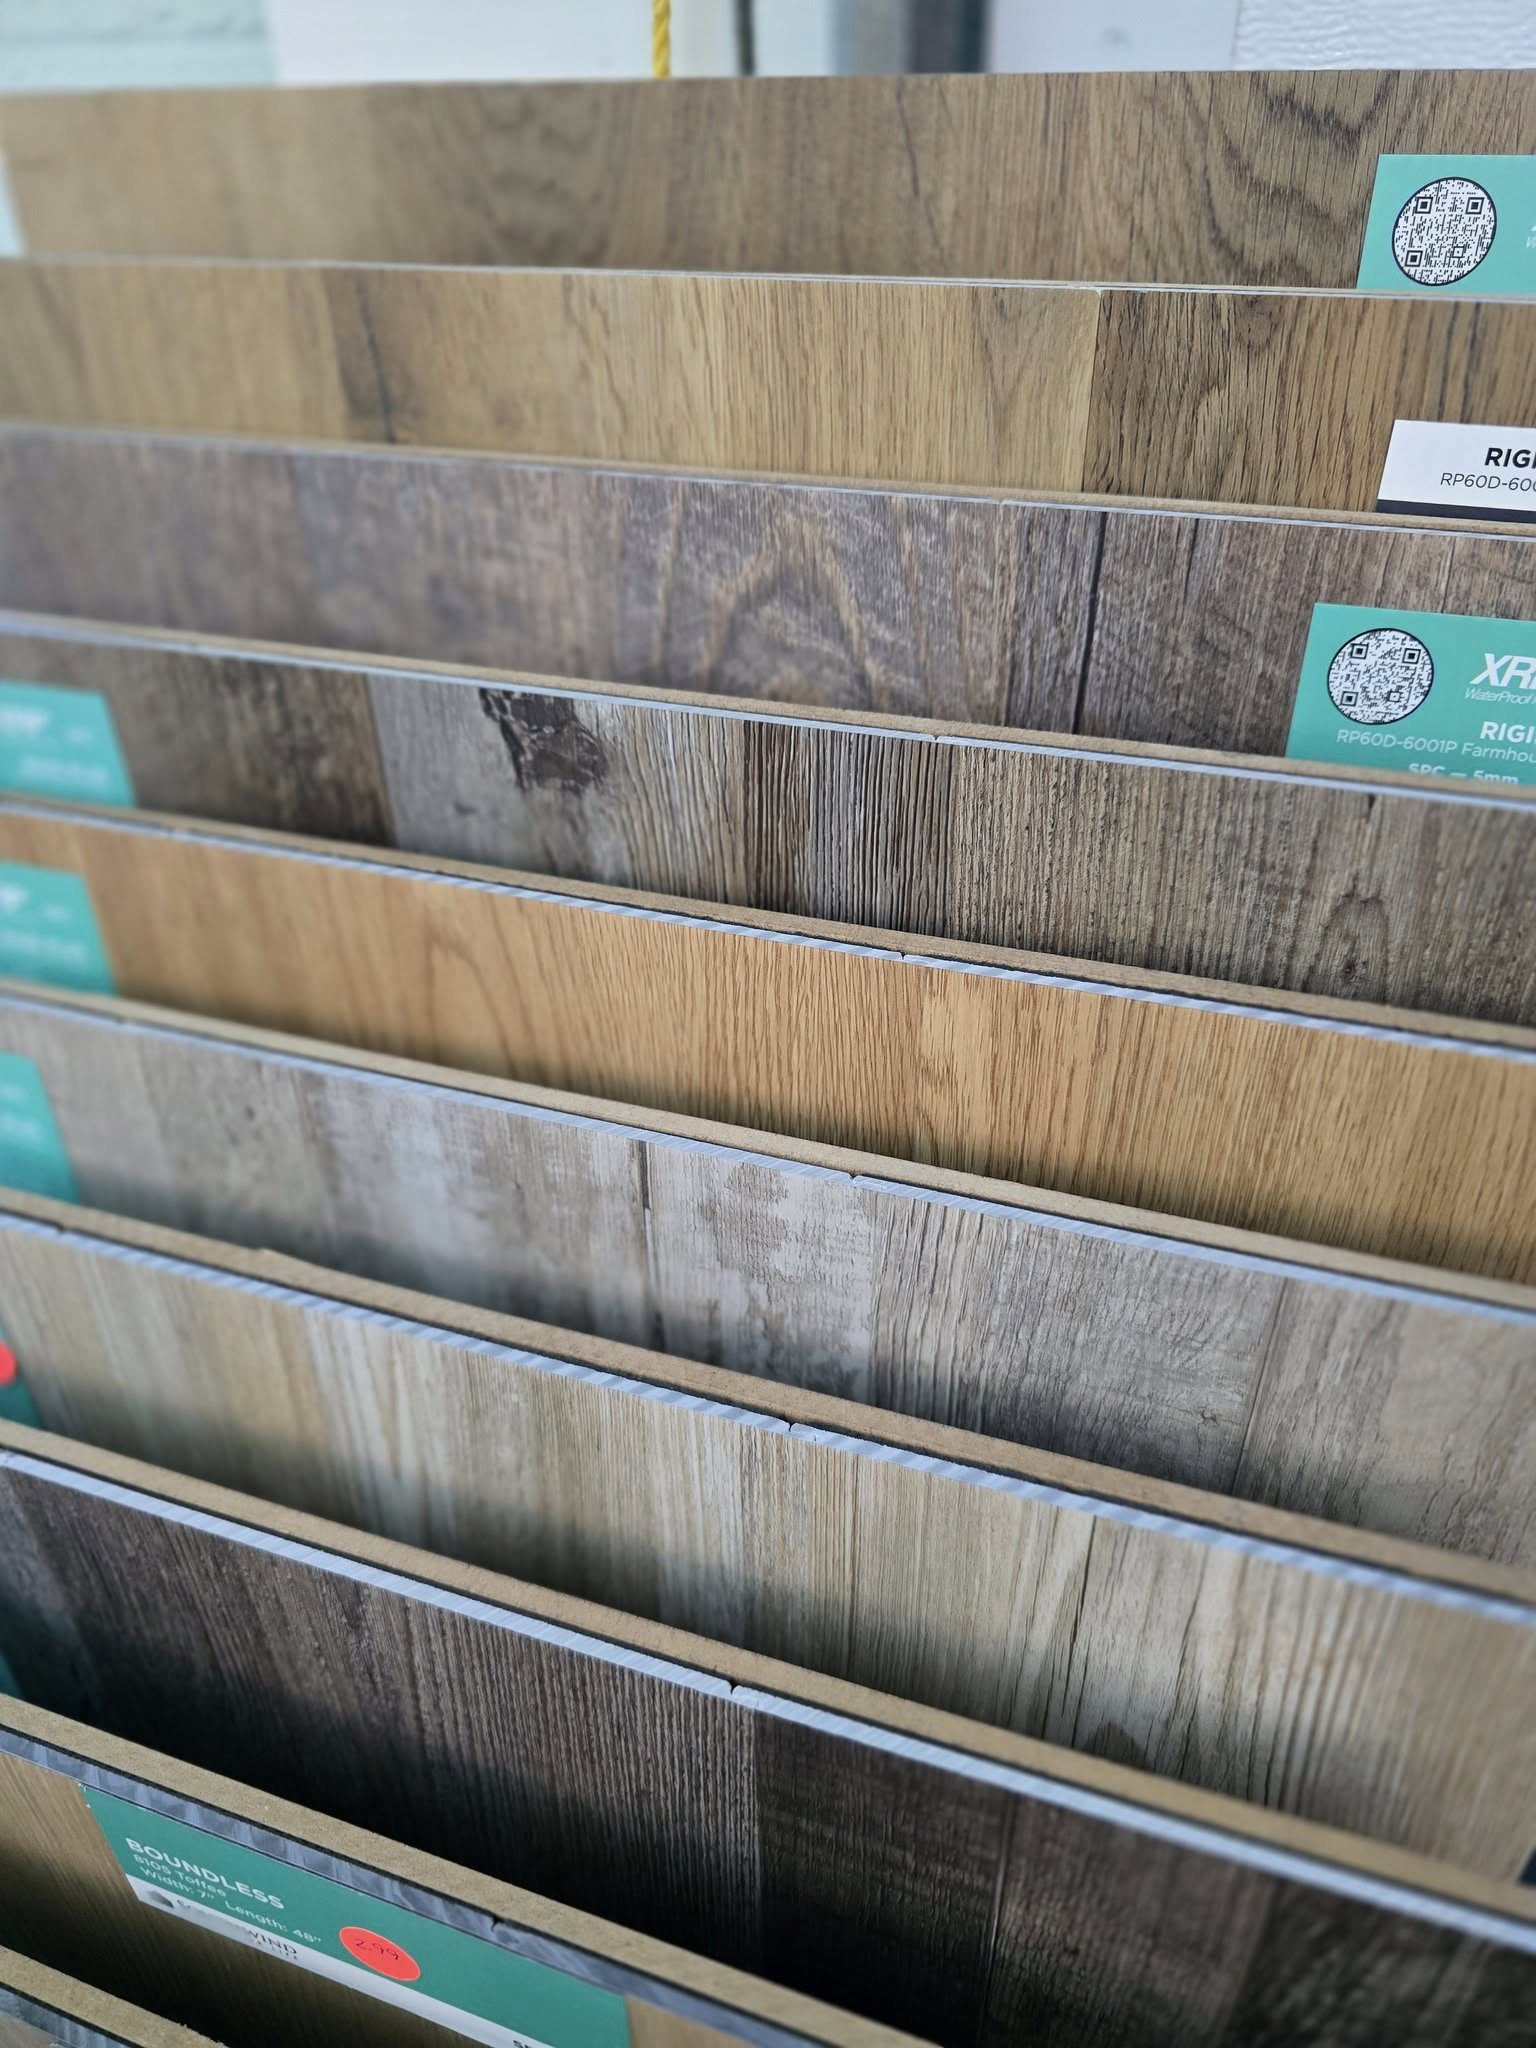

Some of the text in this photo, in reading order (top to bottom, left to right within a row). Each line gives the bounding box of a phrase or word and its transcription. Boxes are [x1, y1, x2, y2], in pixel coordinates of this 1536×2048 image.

[1469, 653, 1536, 690] XR
[1336, 729, 1458, 754] RP60D-6001P
[1479, 721, 1536, 744] RIGI
[125, 1837, 285, 1909] BOUNDLESS
[174, 1870, 227, 1897] Toffee
[139, 1866, 194, 1895] Width:
[224, 1900, 288, 1932] Length:
[354, 1938, 399, 1960] 2.99
